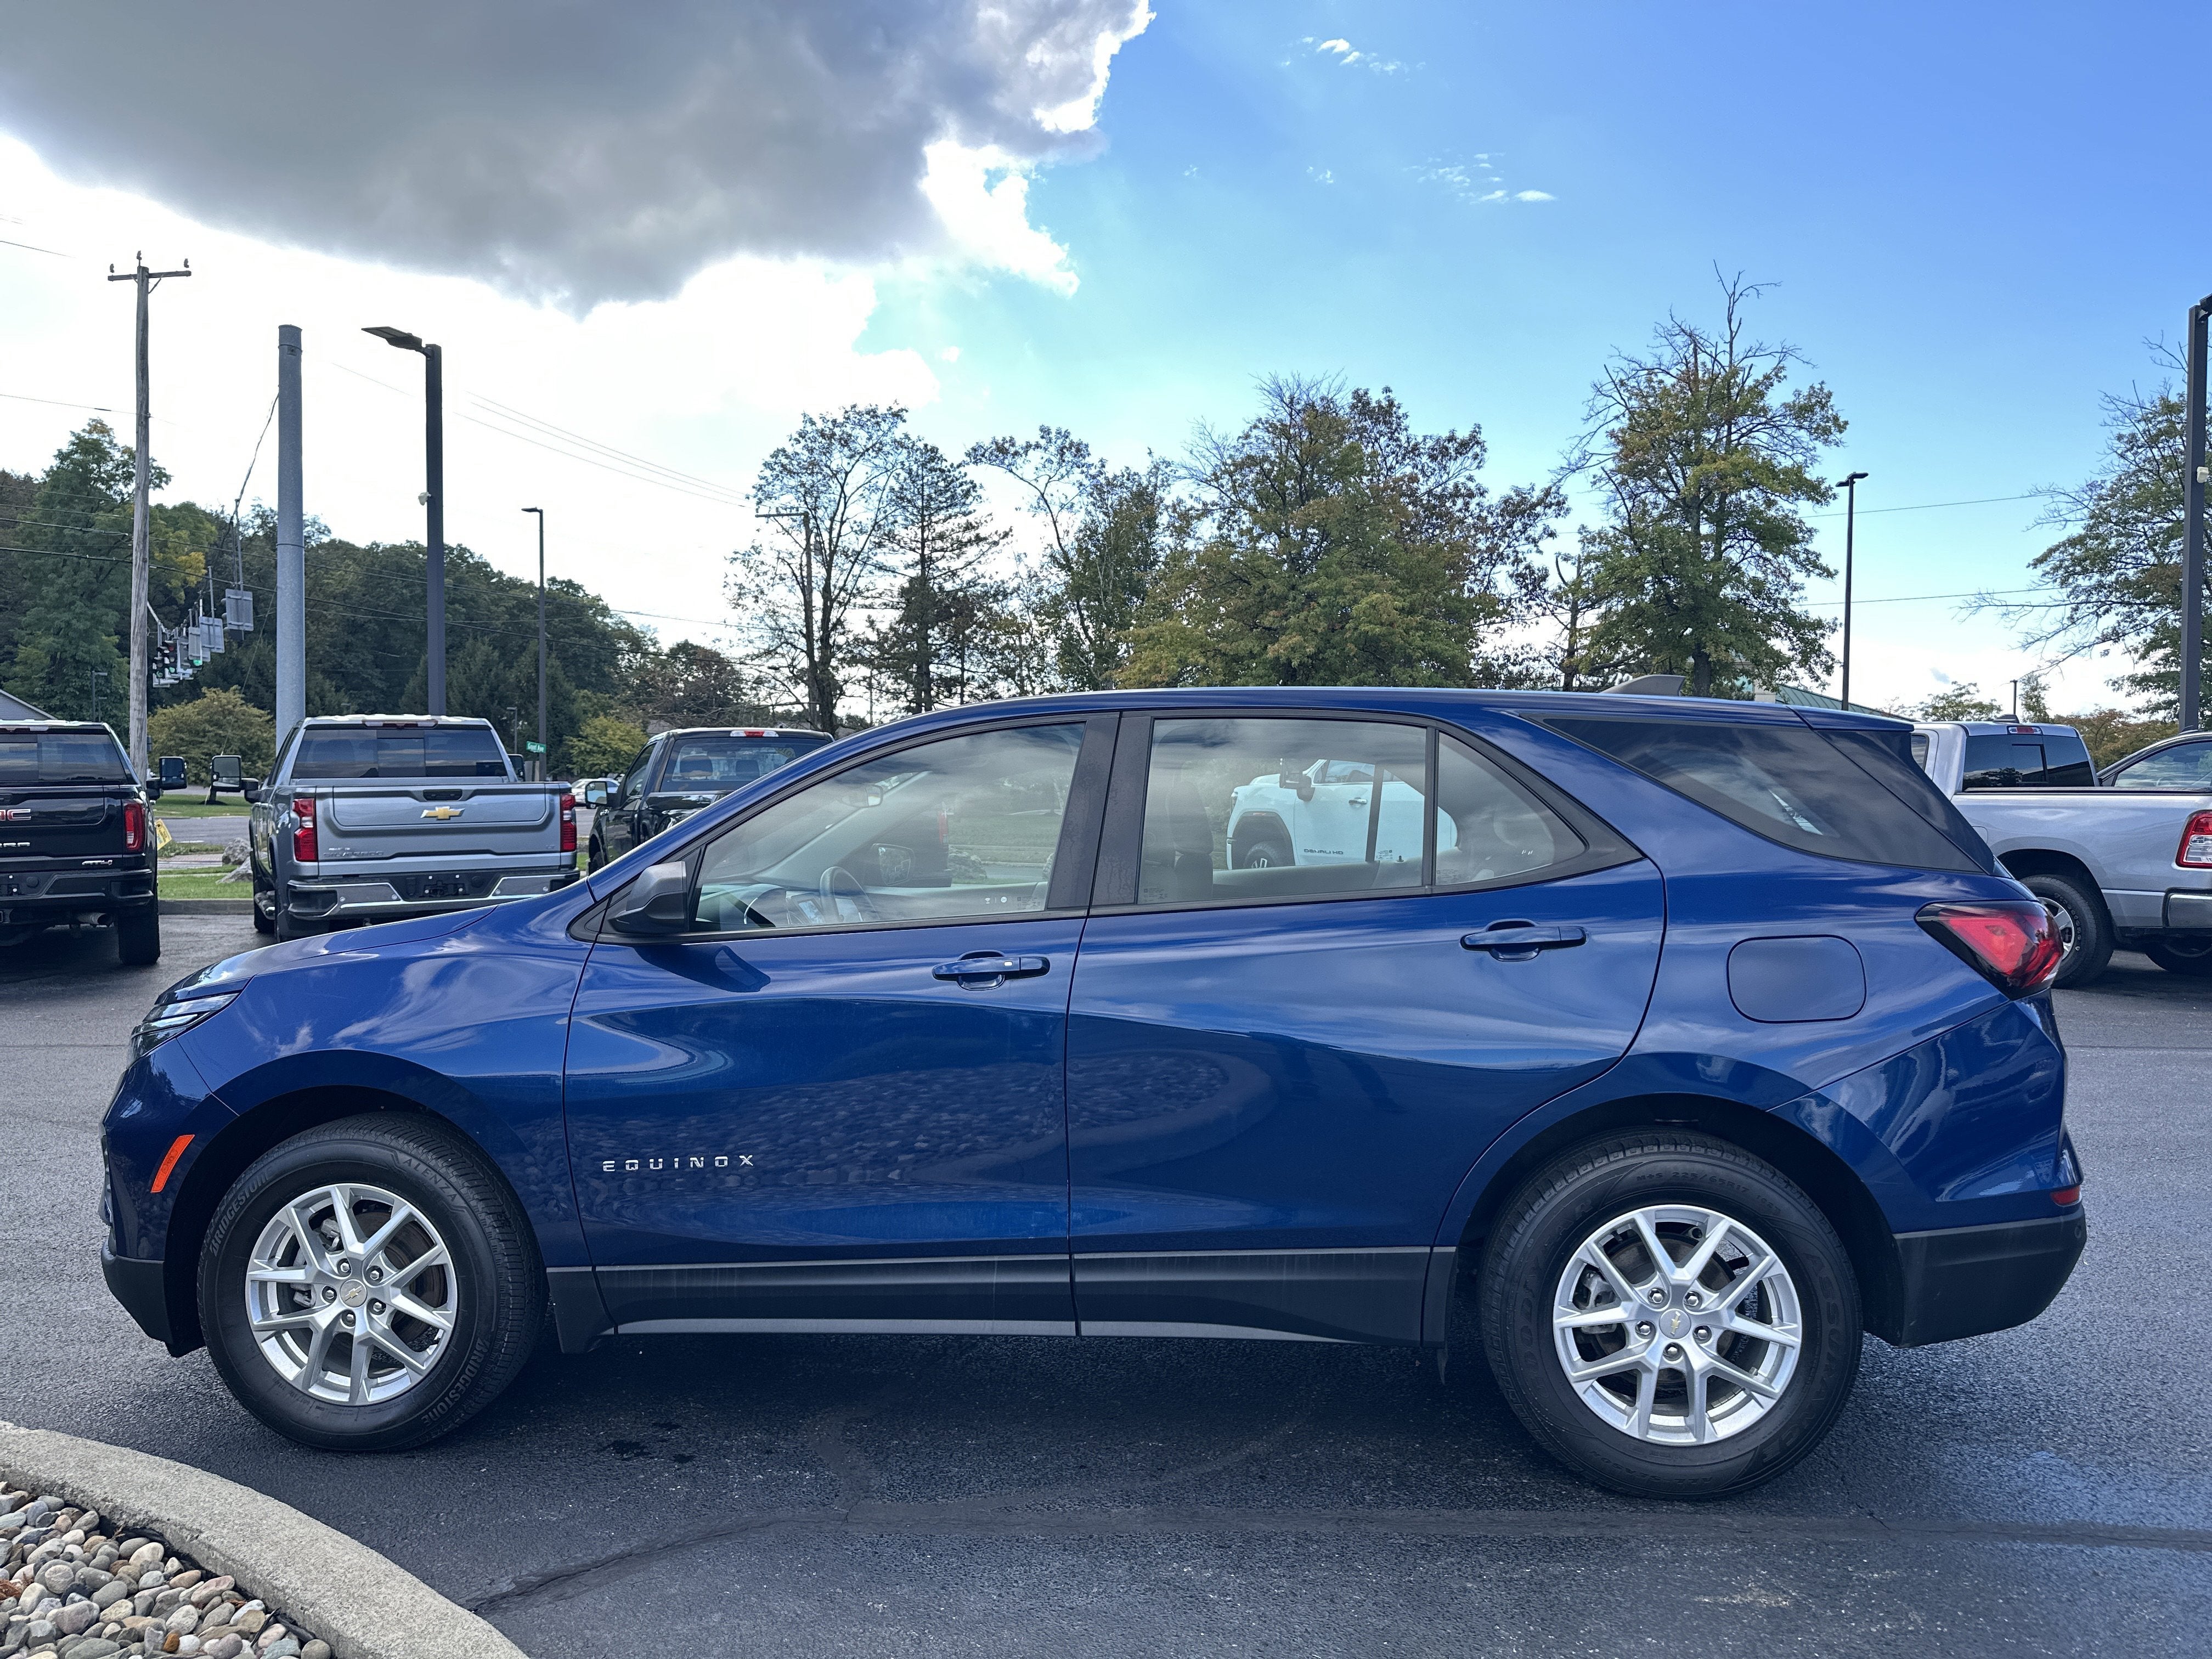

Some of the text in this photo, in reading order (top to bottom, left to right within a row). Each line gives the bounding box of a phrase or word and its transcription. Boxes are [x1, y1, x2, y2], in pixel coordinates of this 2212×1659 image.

[0, 809, 31, 821] C
[403, 1158, 458, 1202] ALENZA
[602, 1155, 754, 1172] EQUINOX
[1636, 1171, 1664, 1182] M+S
[1671, 1171, 1750, 1193] 225/65R17
[208, 1165, 274, 1257] BRIDGESTONE
[1762, 1252, 1844, 1463] ASSURANCE
[421, 1337, 490, 1427] BRIDGESTONE
[1588, 1450, 1713, 1485] ALL-SEASON
